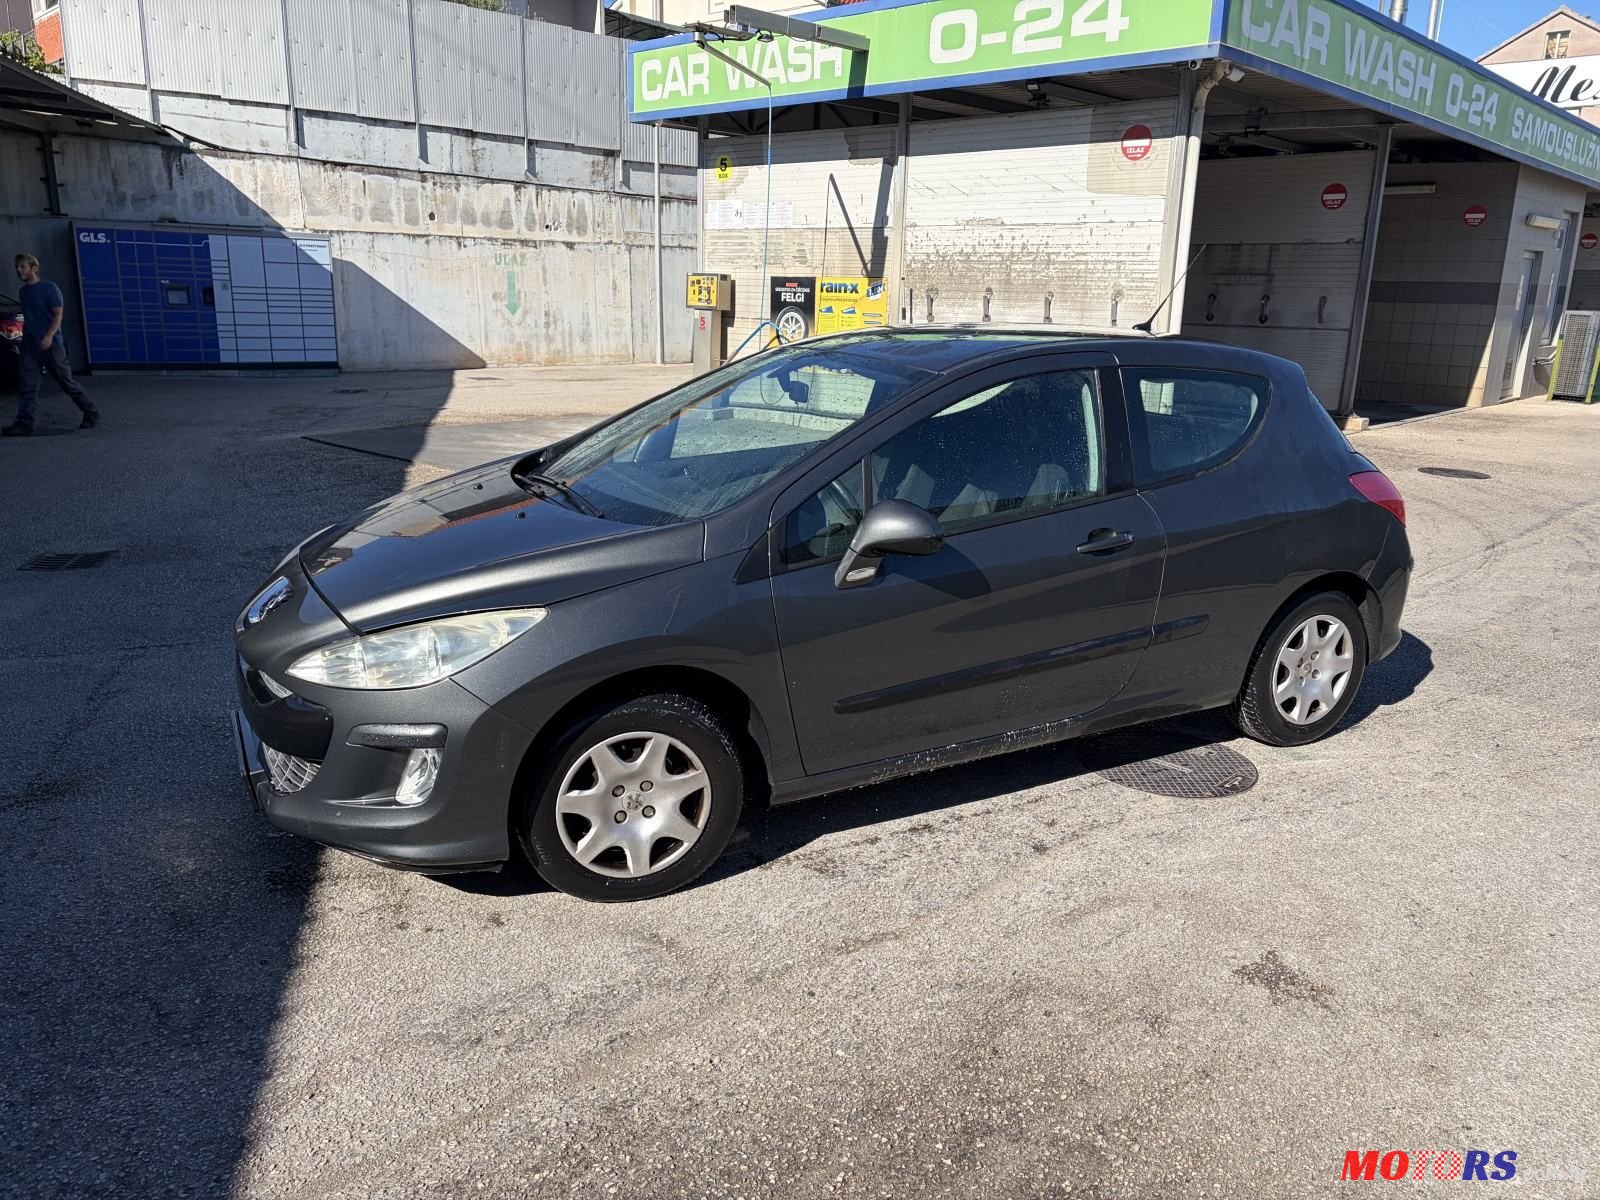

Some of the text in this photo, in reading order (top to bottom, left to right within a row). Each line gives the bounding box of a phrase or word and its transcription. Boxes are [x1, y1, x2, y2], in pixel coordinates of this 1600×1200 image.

[929, 0, 1130, 64] 0-24
[641, 39, 843, 102] CAR WASH
[1241, 0, 1331, 66] CAR
[1344, 21, 1437, 106] WASH
[1445, 73, 1499, 131] 0-24
[719, 157, 728, 172] 5
[494, 252, 528, 267] ULAZ
[781, 292, 805, 303] FELGI
[700, 316, 706, 327] 5
